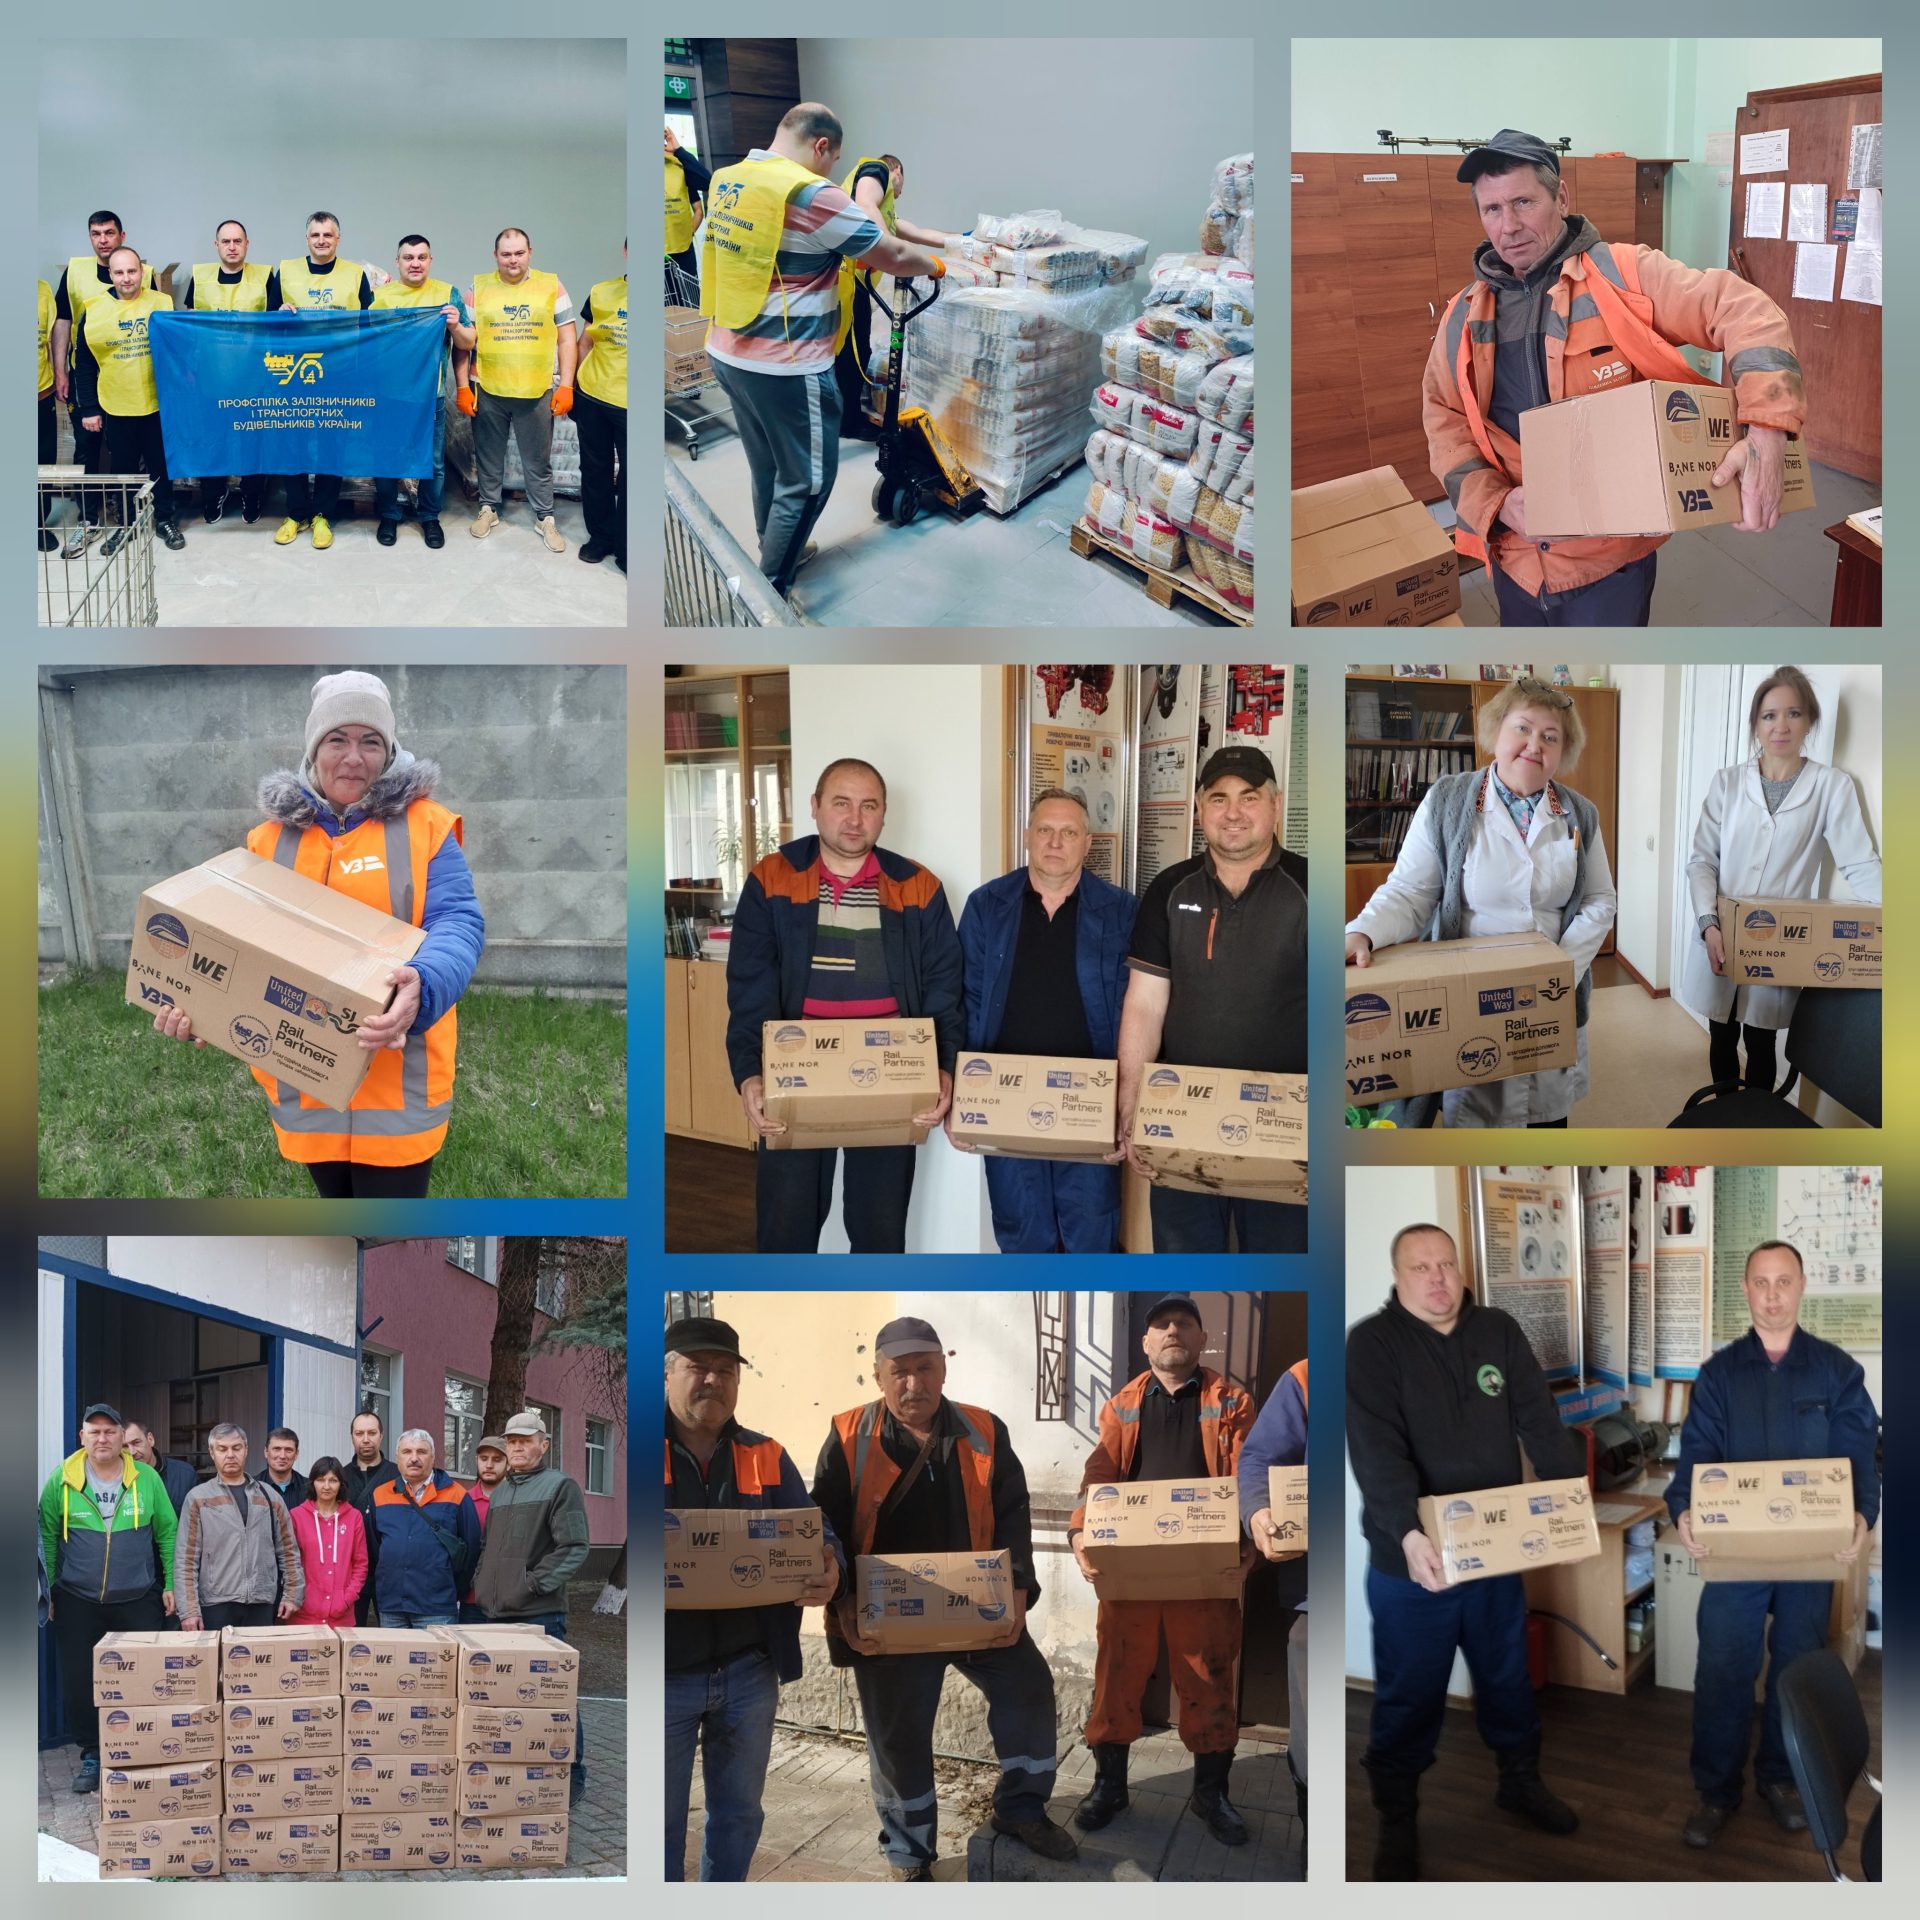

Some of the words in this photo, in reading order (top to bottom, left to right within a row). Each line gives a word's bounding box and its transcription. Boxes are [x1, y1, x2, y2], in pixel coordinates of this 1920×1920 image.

[218, 397, 288, 408] ПРОФСПІЛКА
[291, 397, 376, 407] ЗАЛІЗНИЧНИКІВ
[257, 408, 344, 418] ТРАНСПОРТНИХ
[233, 420, 315, 431] БУДІВЕЛЬНИКІВ
[318, 420, 362, 430] УКРАЇНИ
[1708, 417, 1730, 438] WE
[1698, 461, 1717, 471] NOR
[1784, 458, 1802, 470] tners
[1406, 583, 1418, 594] Way
[1413, 590, 1430, 602] Rail
[1414, 588, 1450, 607] Partners
[1349, 599, 1373, 616] WE
[1834, 921, 1857, 931] United
[1783, 925, 1808, 939] WE
[1843, 929, 1857, 938] Way
[1849, 943, 1866, 953] Rail
[1766, 950, 1786, 958] NOR
[1848, 952, 1882, 963] Partner
[192, 952, 227, 983] WE
[166, 976, 191, 994] NOR
[270, 979, 304, 1003] United
[1480, 989, 1513, 1003] United
[280, 995, 300, 1013] Way
[1493, 999, 1513, 1012] Way
[1404, 1007, 1442, 1030] WE
[1505, 1017, 1529, 1031] Rail
[278, 1019, 304, 1040] Rail
[1505, 1025, 1560, 1042] Partners
[815, 1037, 840, 1049] WE
[875, 1038, 889, 1046] Way
[275, 1030, 336, 1068] Partners
[1381, 1048, 1412, 1062] NOR
[884, 1058, 925, 1067] Partners
[1048, 1071, 1071, 1079] United
[1000, 1074, 1023, 1087] WE
[1056, 1078, 1070, 1087] Way
[1187, 1085, 1213, 1099] WE
[1242, 1084, 1268, 1094] United
[1062, 1093, 1080, 1103] Rail
[1251, 1092, 1267, 1101] Way
[1061, 1102, 1103, 1113] Partners
[1257, 1107, 1276, 1118] Rail
[1255, 1116, 1303, 1130] Partners
[1126, 1494, 1149, 1506] WE
[1187, 1512, 1226, 1521] Partners
[749, 1520, 774, 1529] United
[759, 1528, 775, 1537] Way
[692, 1531, 720, 1546] WE
[769, 1549, 787, 1558] Rail
[769, 1558, 812, 1568] Partners
[255, 1654, 272, 1664] WE
[376, 1654, 393, 1664] WE
[117, 1661, 136, 1671] WE
[495, 1663, 513, 1673] WE
[540, 1682, 569, 1690] Partners
[257, 1715, 275, 1726] WE
[377, 1712, 395, 1722] WE
[136, 1722, 155, 1731] WE
[528, 1741, 546, 1751] WE
[259, 1773, 276, 1783] WE
[377, 1769, 394, 1779] WE
[133, 1780, 152, 1790] WE
[494, 1775, 512, 1785] WE
[182, 1792, 212, 1801] Partners
[305, 1789, 333, 1797] Partners
[256, 1831, 273, 1841] WE
[487, 1827, 504, 1837] WE
[406, 1847, 424, 1856] WE
[168, 1855, 185, 1864] WE
